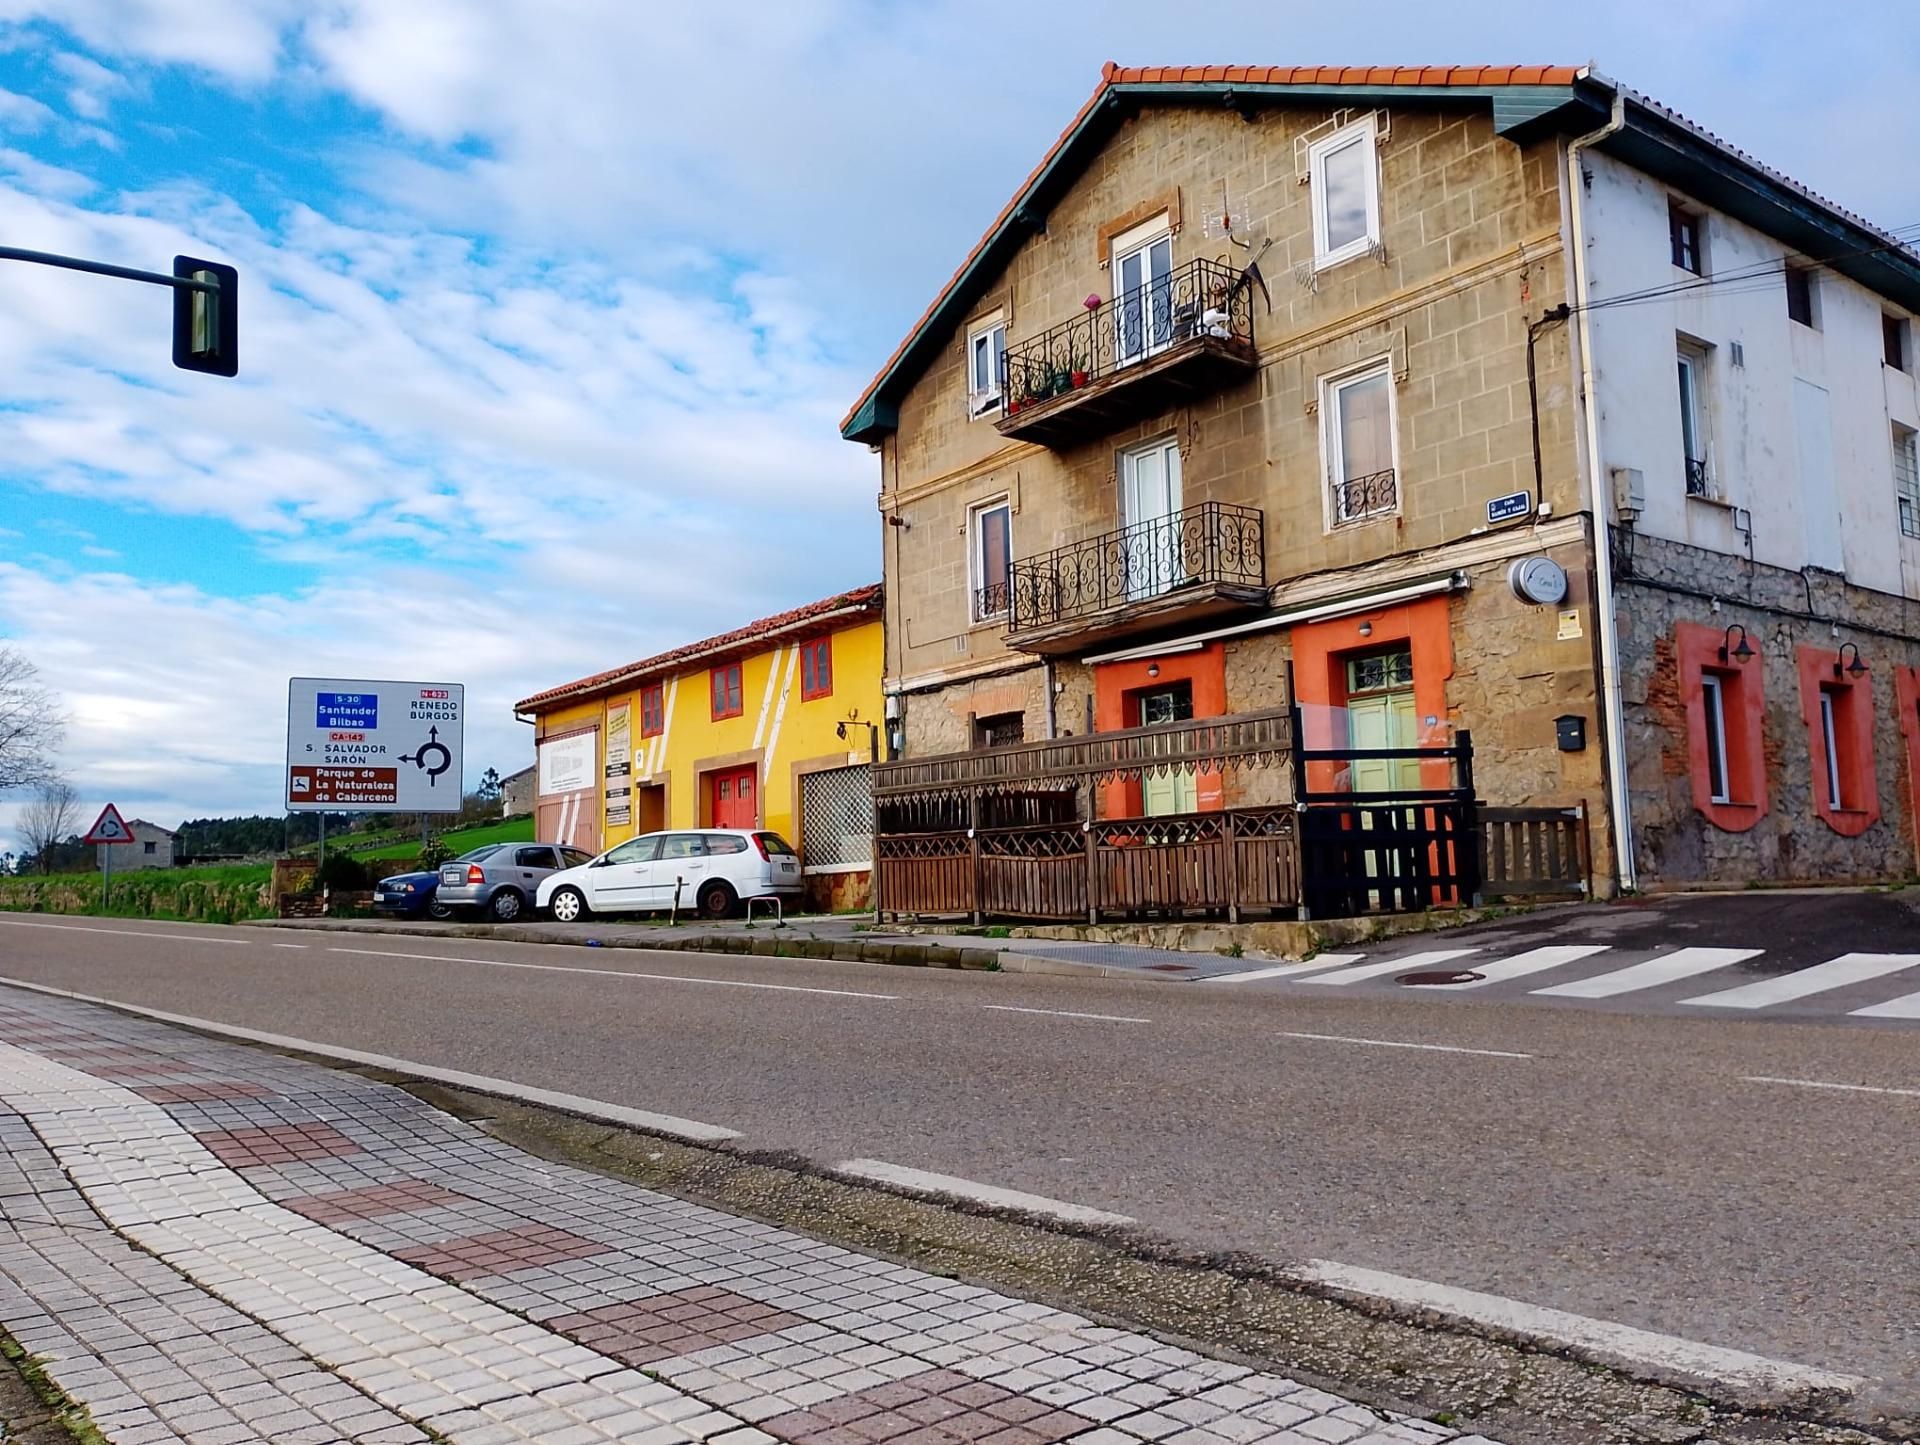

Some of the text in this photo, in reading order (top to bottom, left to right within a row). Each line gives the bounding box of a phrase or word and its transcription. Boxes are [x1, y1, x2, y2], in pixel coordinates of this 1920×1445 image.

[337, 695, 359, 703] S-30
[421, 690, 448, 698] N-623
[319, 705, 376, 715] Santander
[411, 700, 457, 710] RENEDO
[410, 711, 458, 720] BURGOS
[329, 717, 365, 727] Bilbao
[331, 732, 363, 741] CA-142
[305, 743, 387, 754] S. SALVADOR
[324, 754, 367, 764] SARÓN
[316, 768, 375, 778] Parque de
[316, 780, 395, 790] La Naturaleza
[316, 792, 395, 802] de Cabárceno
